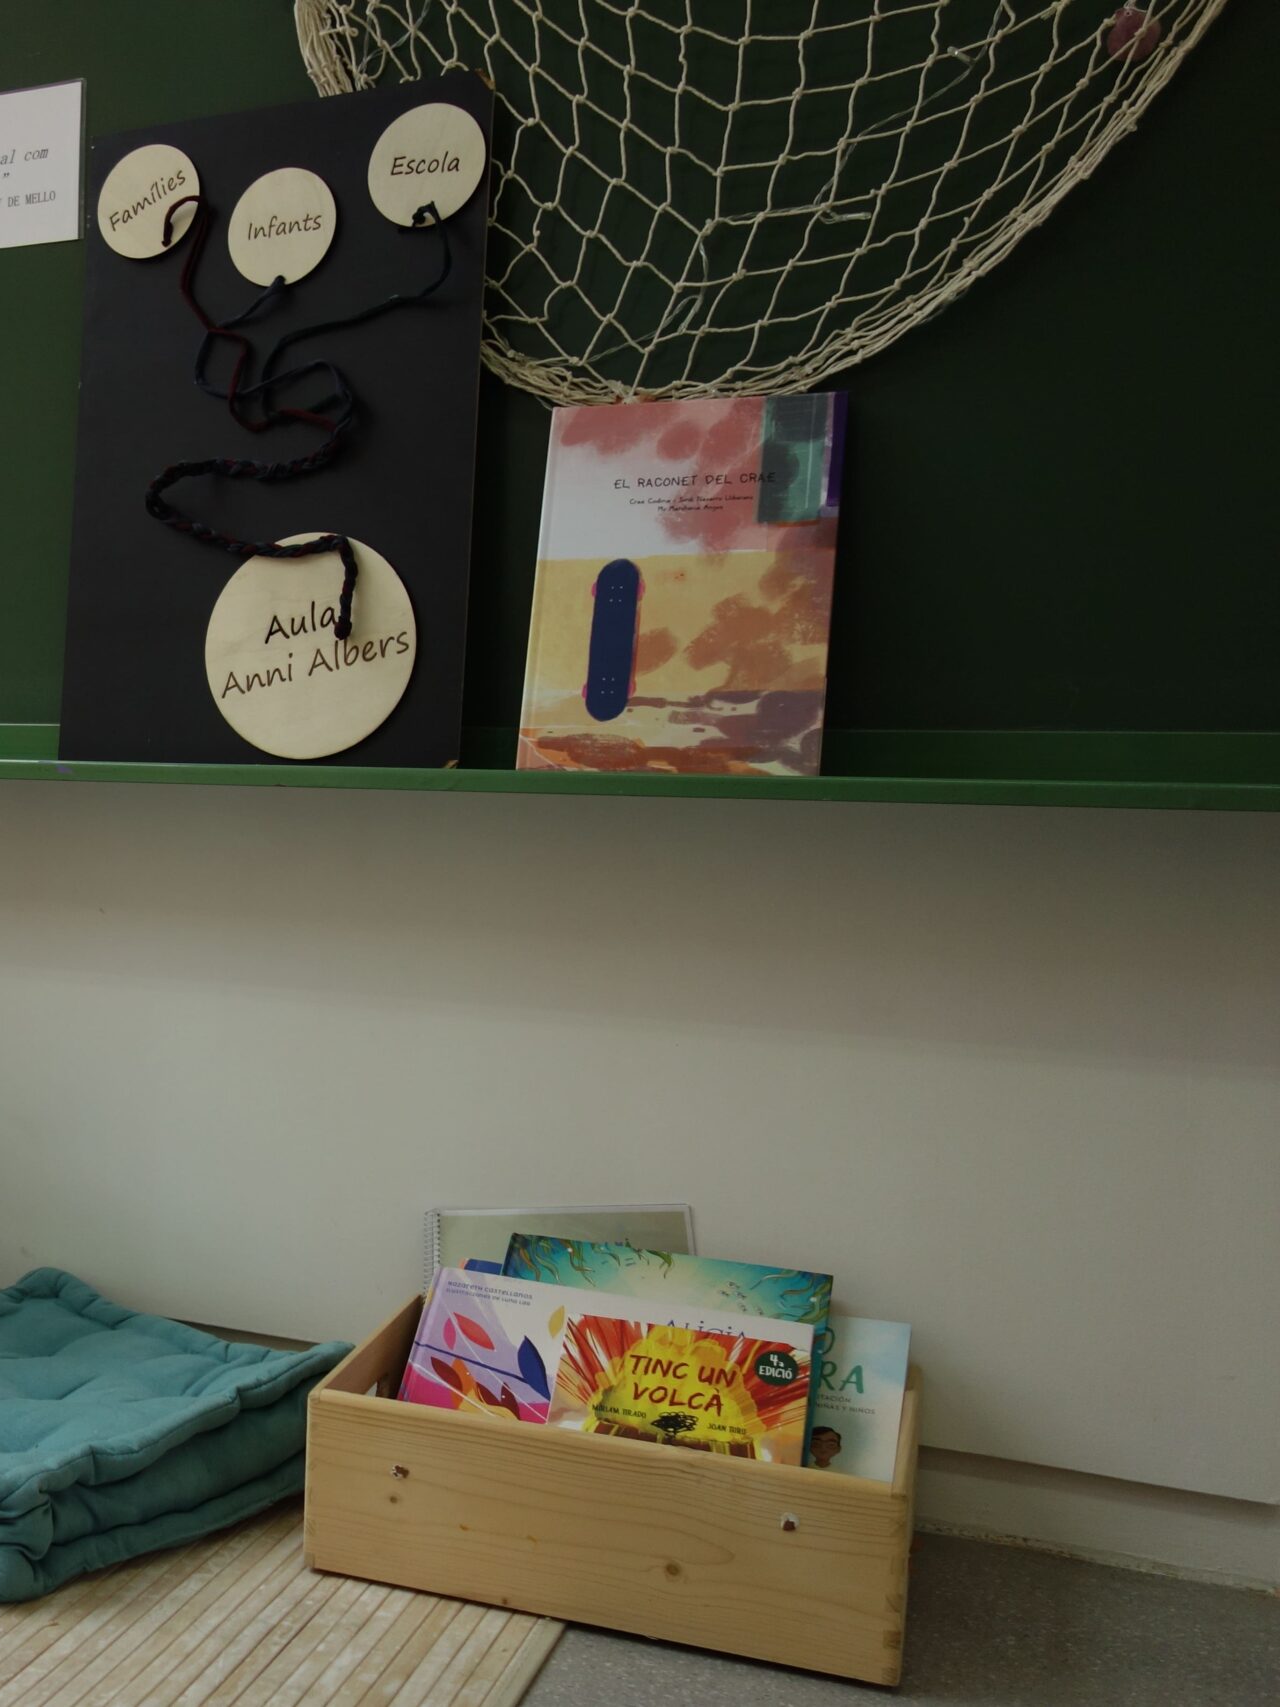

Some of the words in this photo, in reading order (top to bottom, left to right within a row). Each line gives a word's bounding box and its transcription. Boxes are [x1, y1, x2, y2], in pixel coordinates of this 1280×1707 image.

[23, 147, 49, 162] com
[390, 150, 461, 177] Escola
[7, 195, 20, 207] DE
[25, 190, 56, 205] MELLO
[108, 168, 188, 232] Famílies
[247, 212, 322, 241] Infants
[614, 479, 631, 490] EL
[637, 474, 698, 488] RACONET
[705, 473, 732, 485] DEL
[740, 471, 777, 484] CRAE
[265, 600, 338, 644] Aula
[221, 652, 293, 699] Anni
[308, 631, 410, 677] Albers
[630, 1354, 689, 1380] TINC
[697, 1365, 738, 1388] UN
[758, 1365, 793, 1380] EDICIÓ
[622, 1407, 646, 1419] TIRADO
[632, 1382, 724, 1417] VOLCÀ
[706, 1422, 726, 1433] JOAN
